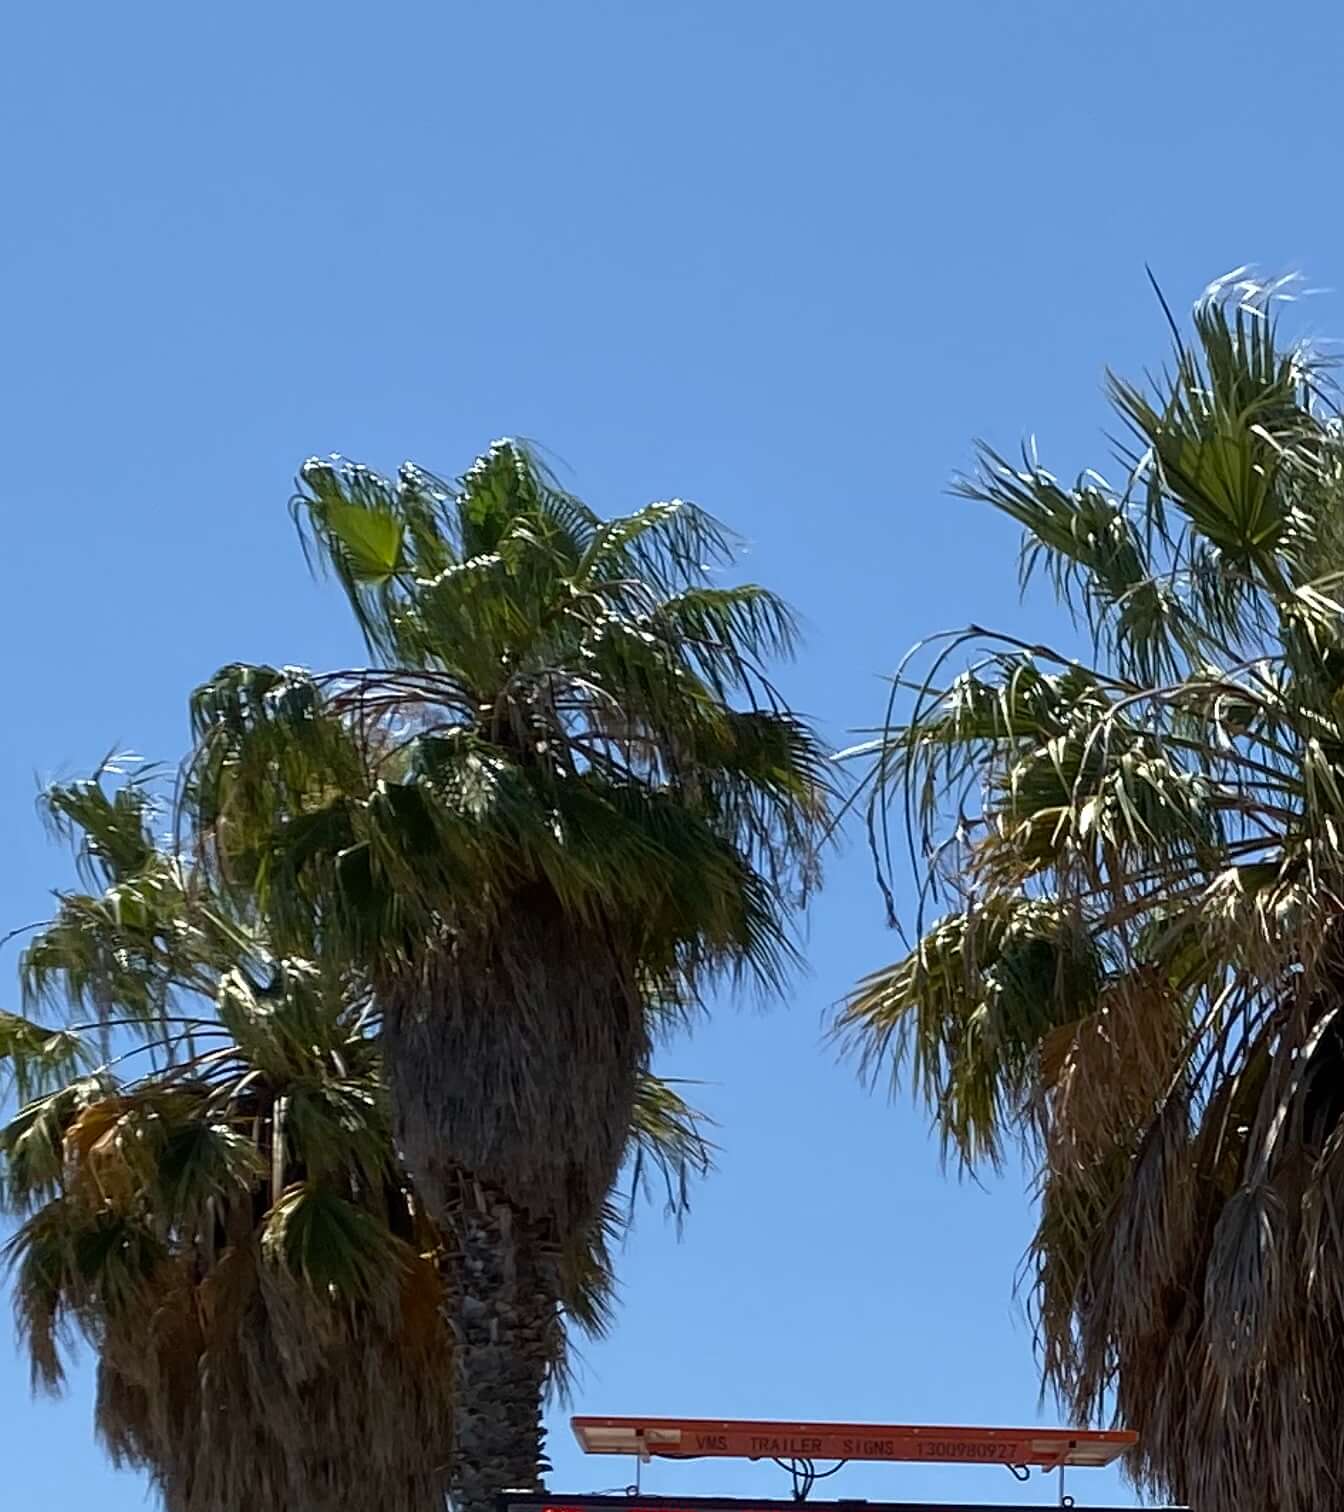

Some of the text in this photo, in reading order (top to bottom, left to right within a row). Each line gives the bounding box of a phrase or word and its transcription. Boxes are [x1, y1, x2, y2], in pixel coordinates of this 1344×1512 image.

[696, 1434, 1017, 1459] VMS TRAILER SIGNS 1300980927
